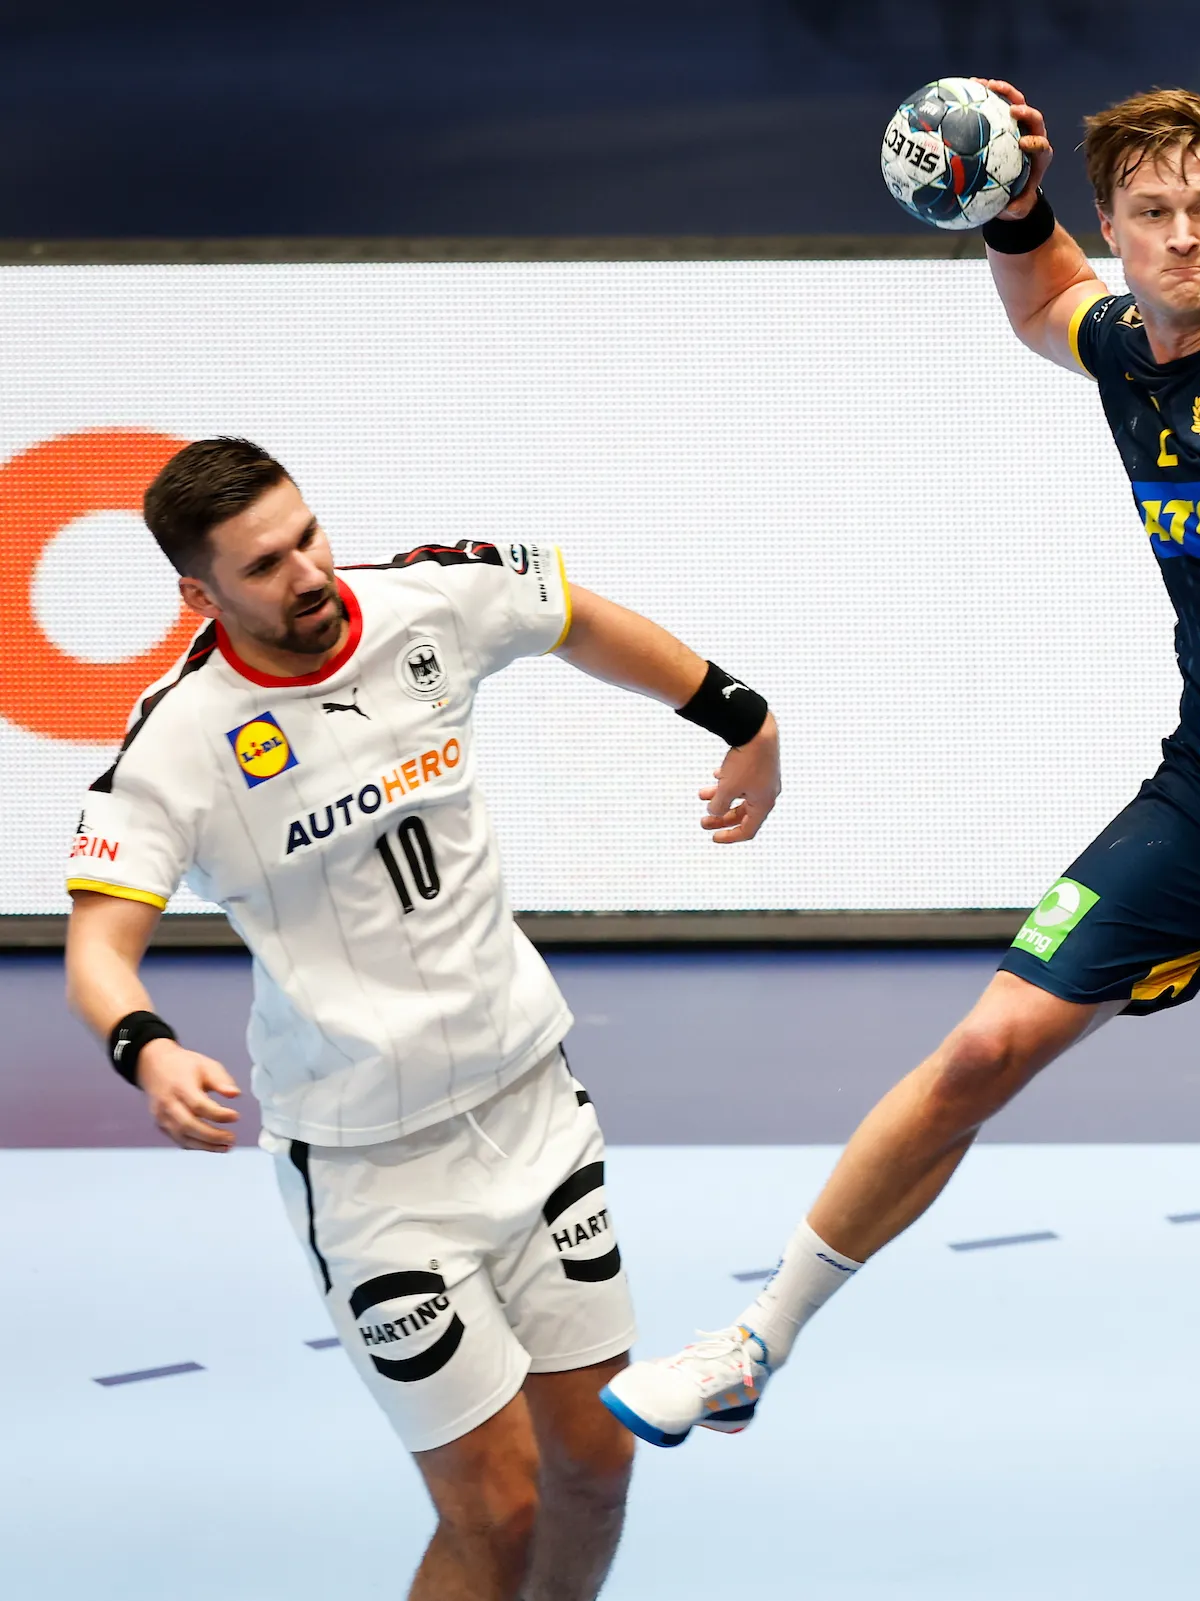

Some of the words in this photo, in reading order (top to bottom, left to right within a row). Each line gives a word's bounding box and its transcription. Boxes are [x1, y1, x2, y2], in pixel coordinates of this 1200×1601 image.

[286, 738, 460, 855] AUTOHERO
[375, 815, 441, 915] 10
[359, 1295, 450, 1347] HARTING
